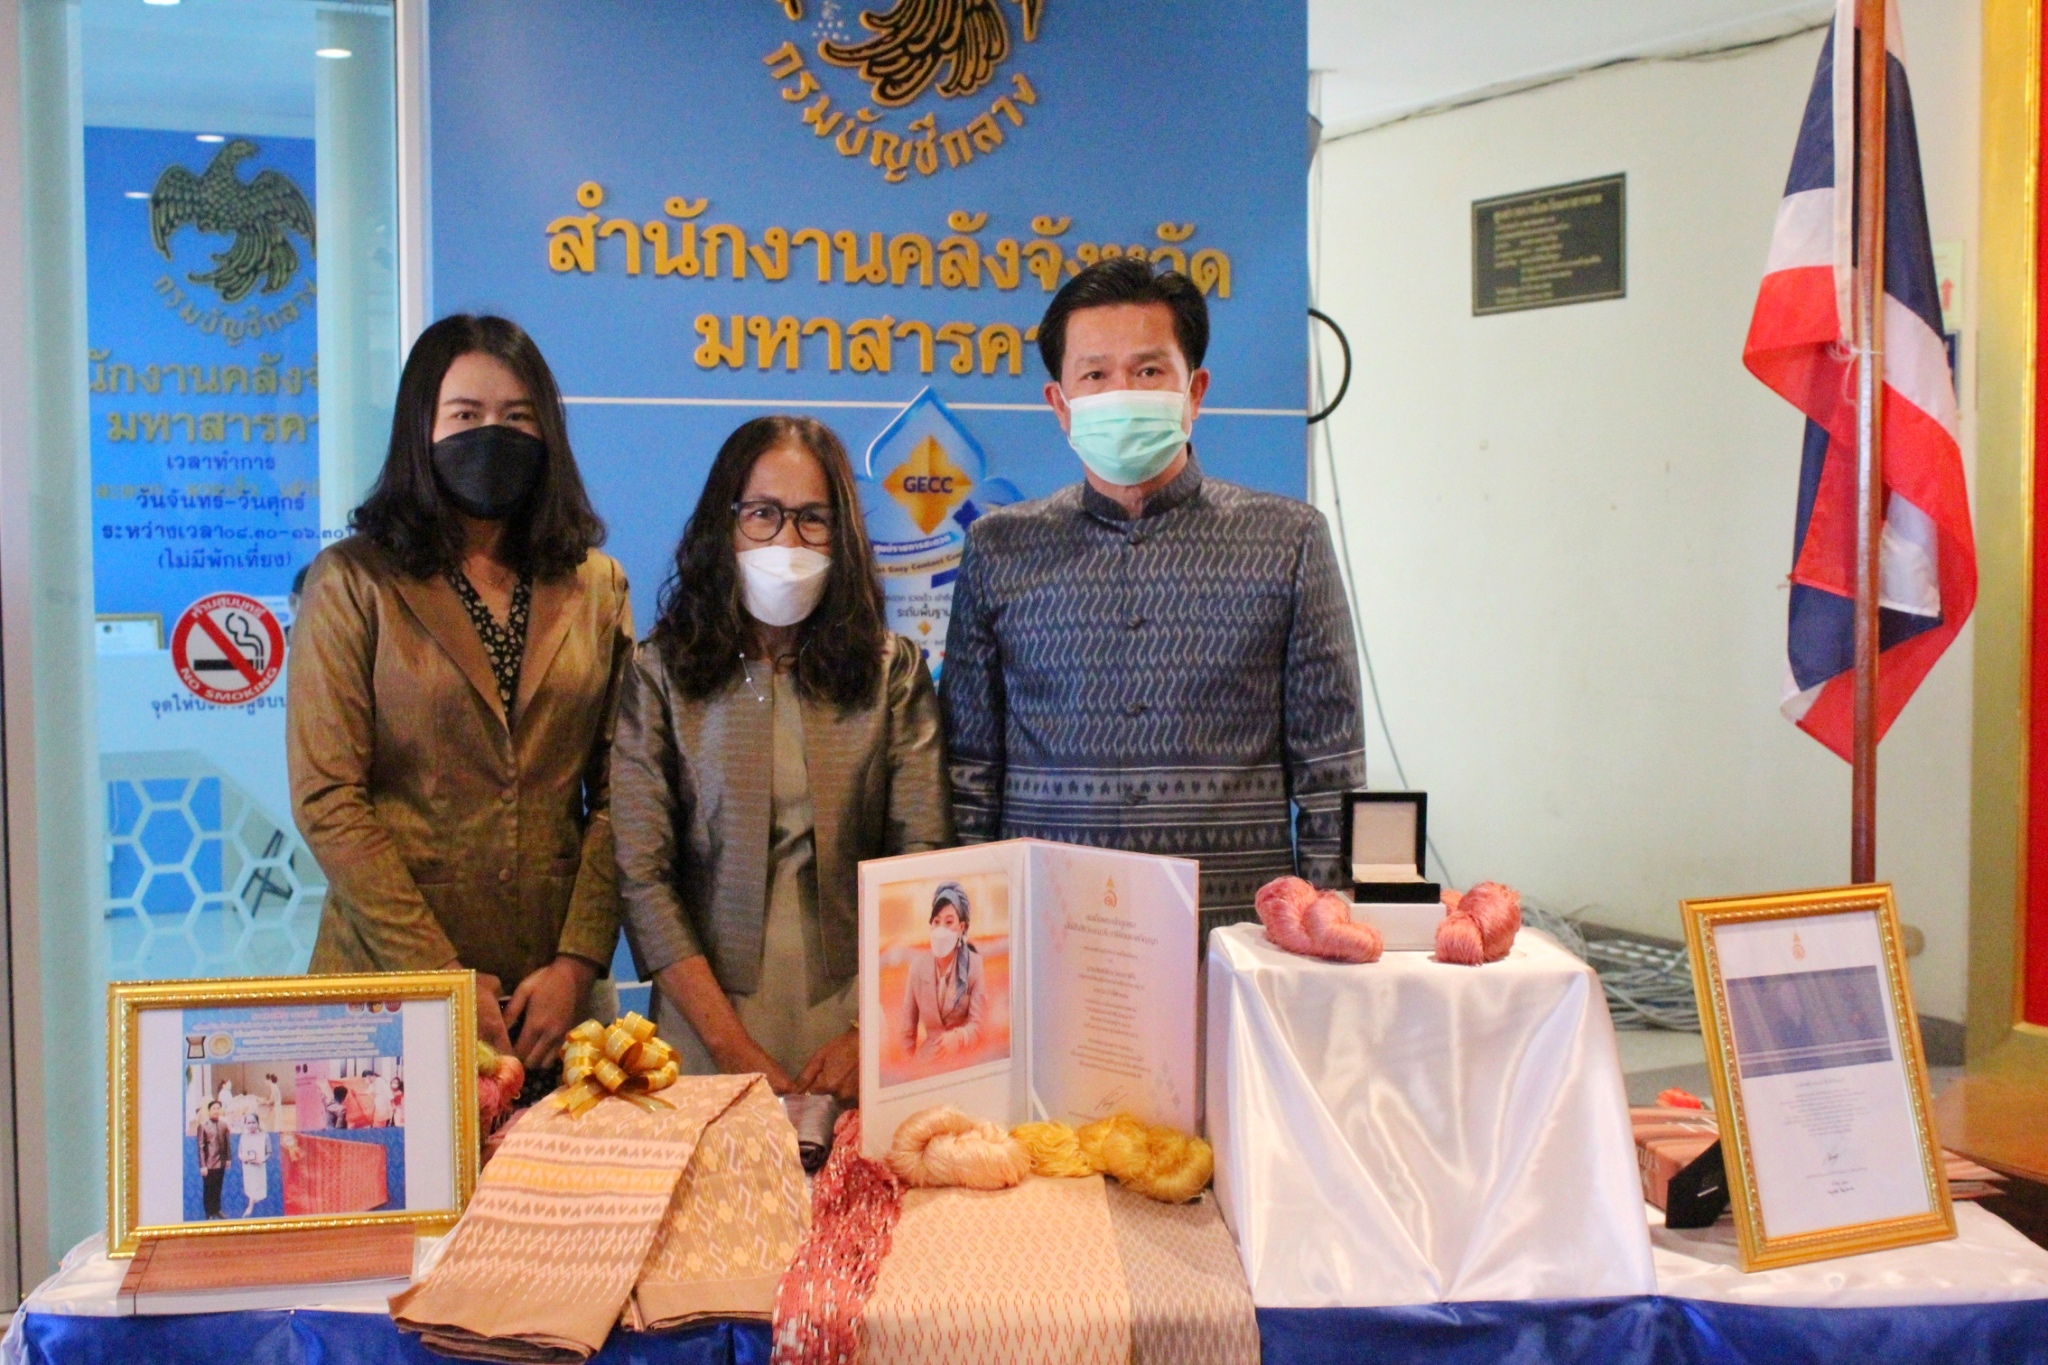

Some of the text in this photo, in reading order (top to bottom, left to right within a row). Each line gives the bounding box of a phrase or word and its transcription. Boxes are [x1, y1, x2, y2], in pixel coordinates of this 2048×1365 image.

[762, 41, 1037, 184] กรมบัญชีกลาง
[166, 449, 276, 470] เวลาทำการ
[903, 476, 953, 494] GECC
[180, 666, 278, 702] NO SMOKING
